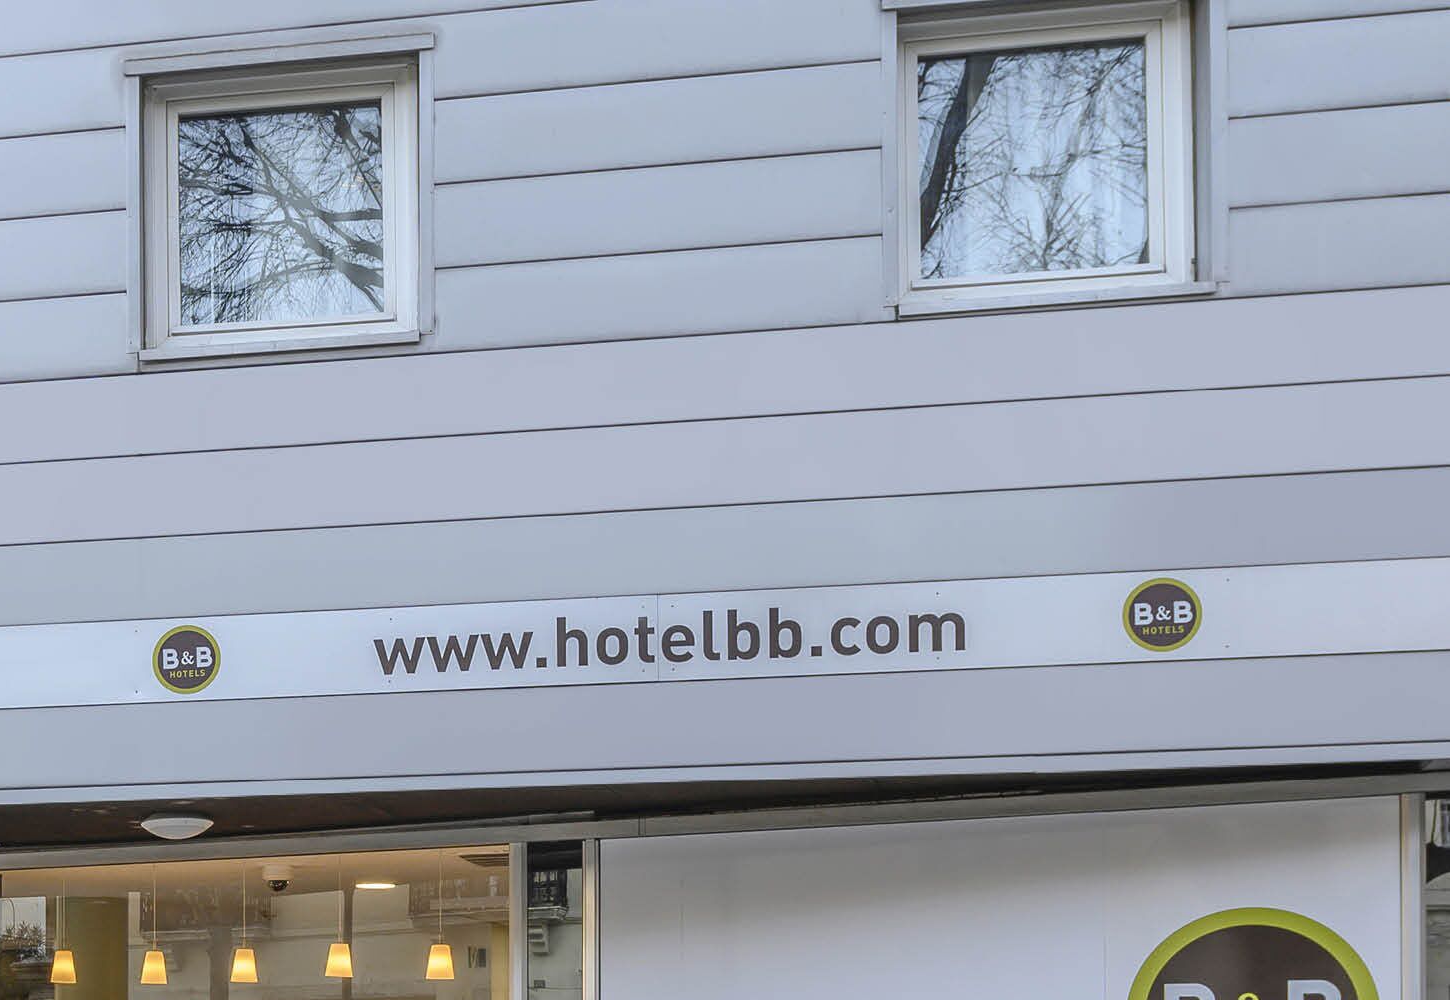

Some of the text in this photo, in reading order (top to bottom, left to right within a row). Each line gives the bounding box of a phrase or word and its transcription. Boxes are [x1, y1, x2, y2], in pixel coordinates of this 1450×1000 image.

[1134, 600, 1193, 626] B&B
[373, 607, 966, 676] www.hotelbb.com
[1142, 625, 1185, 635] HOTELS
[162, 646, 213, 670] B&B
[169, 669, 206, 679] HOTELS
